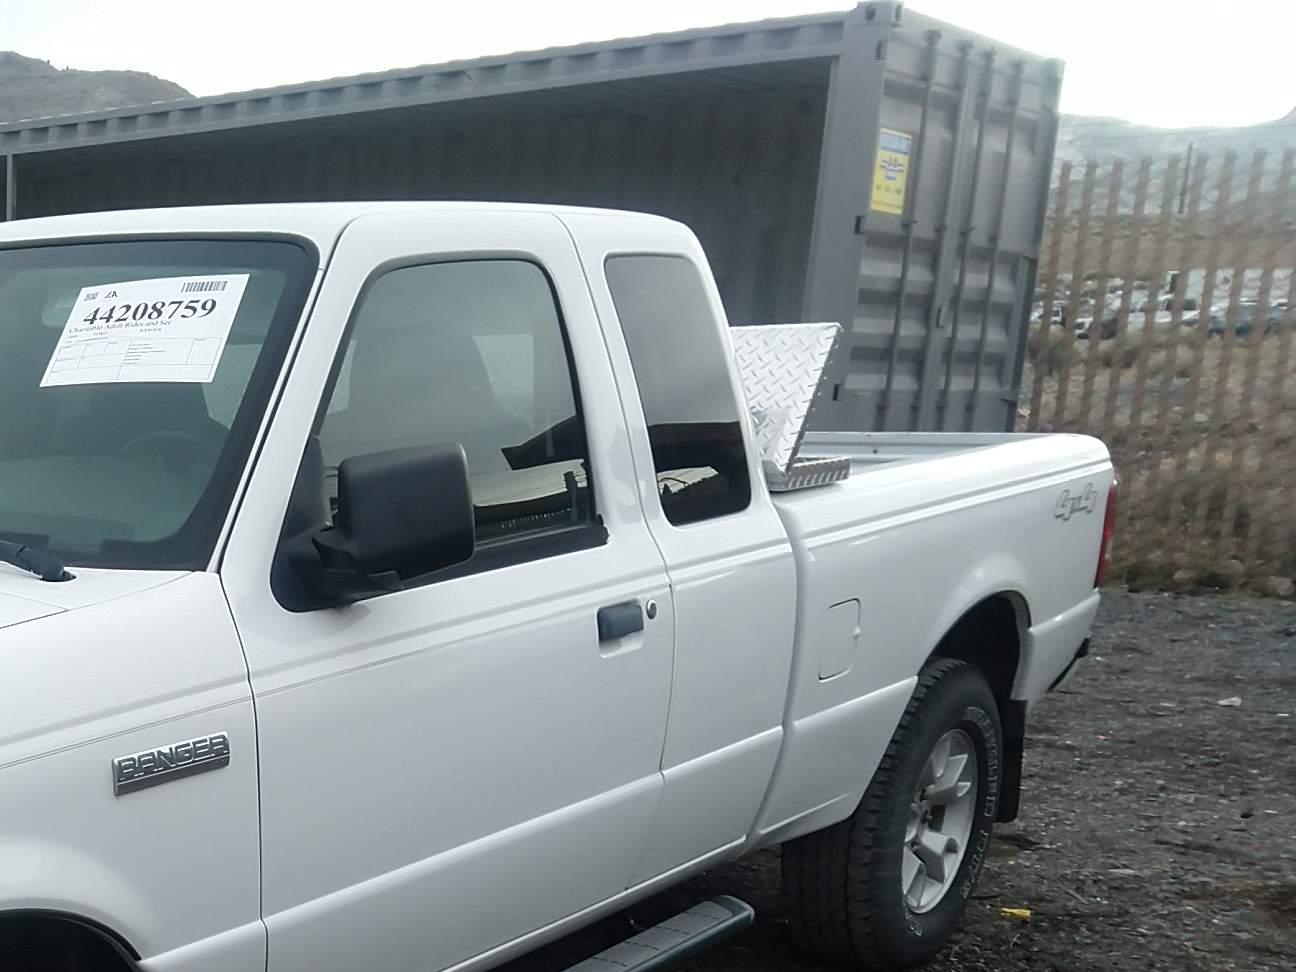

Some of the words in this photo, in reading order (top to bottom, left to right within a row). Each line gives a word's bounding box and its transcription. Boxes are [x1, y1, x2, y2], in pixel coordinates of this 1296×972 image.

[83, 298, 217, 325] 44208759
[104, 322, 124, 331] Adult
[124, 321, 144, 330] Rides
[117, 734, 230, 781] RANGER
